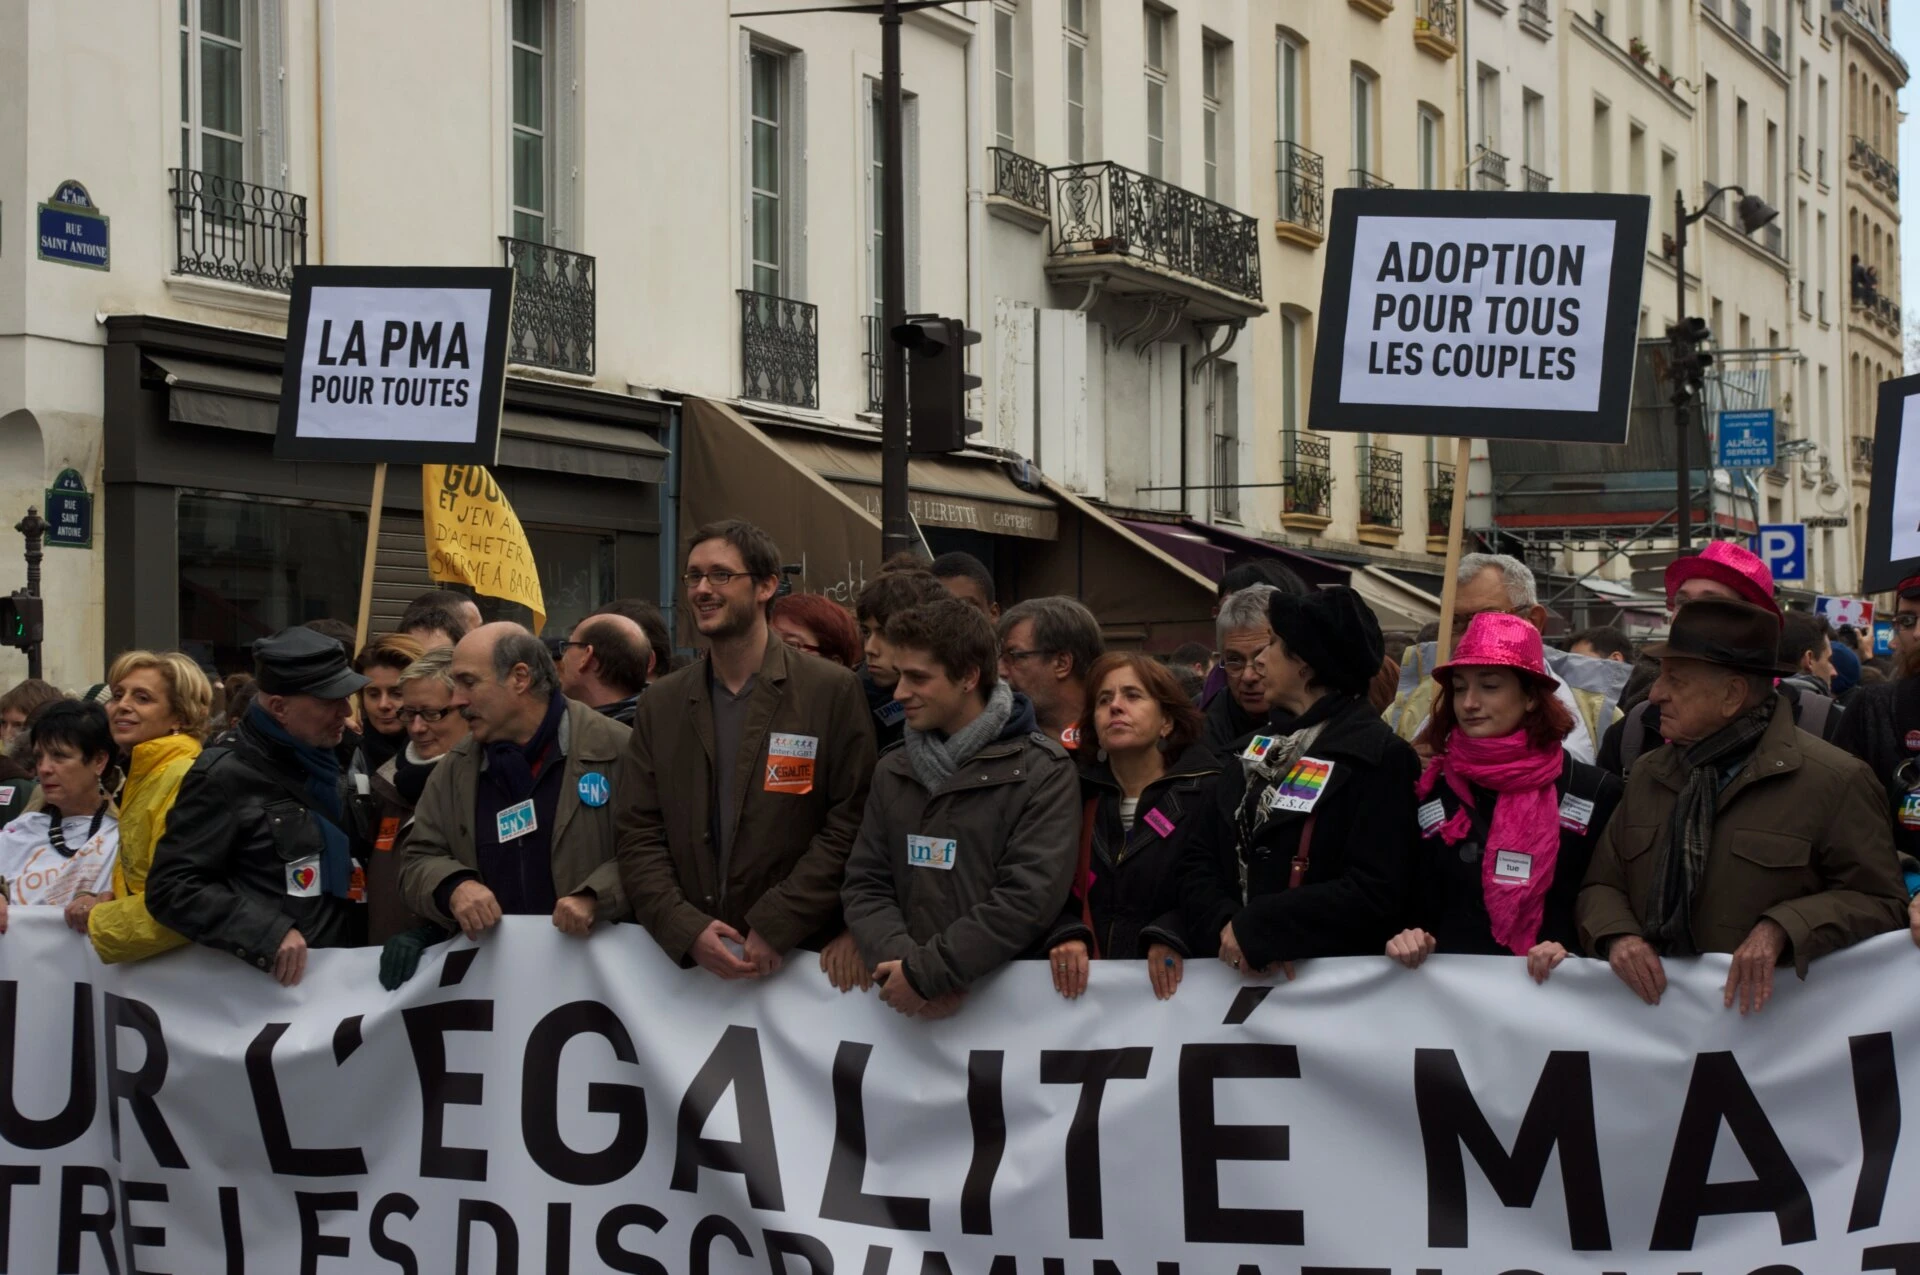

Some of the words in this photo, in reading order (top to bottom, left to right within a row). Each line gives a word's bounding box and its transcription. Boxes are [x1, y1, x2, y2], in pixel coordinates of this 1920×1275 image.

[65, 222, 83, 236] RUE
[41, 235, 68, 251] SAINT
[70, 241, 107, 258] ANTOINE
[1376, 241, 1585, 286] ADOPTION
[1372, 293, 1473, 333] POUR
[1485, 296, 1580, 336] TOUS
[318, 319, 367, 367] LA
[380, 320, 470, 369] PMA
[1368, 341, 1424, 376] LES
[1432, 343, 1576, 381] COUPLES
[311, 375, 374, 405] POUR
[381, 377, 470, 407] TOUTES
[64, 499, 77, 510] RUE
[439, 489, 458, 512] ET
[443, 465, 511, 512] GOU
[61, 513, 78, 523] SAINT
[457, 506, 495, 527] J'EN
[924, 501, 977, 525] LURETTE
[57, 526, 82, 537] ANTOINE
[435, 523, 525, 565] D'ACHETER
[1761, 531, 1796, 568] P
[432, 551, 490, 585] SPERME
[1506, 864, 1520, 872] tue
[244, 947, 1305, 1246] L'ÉGALITÉ
